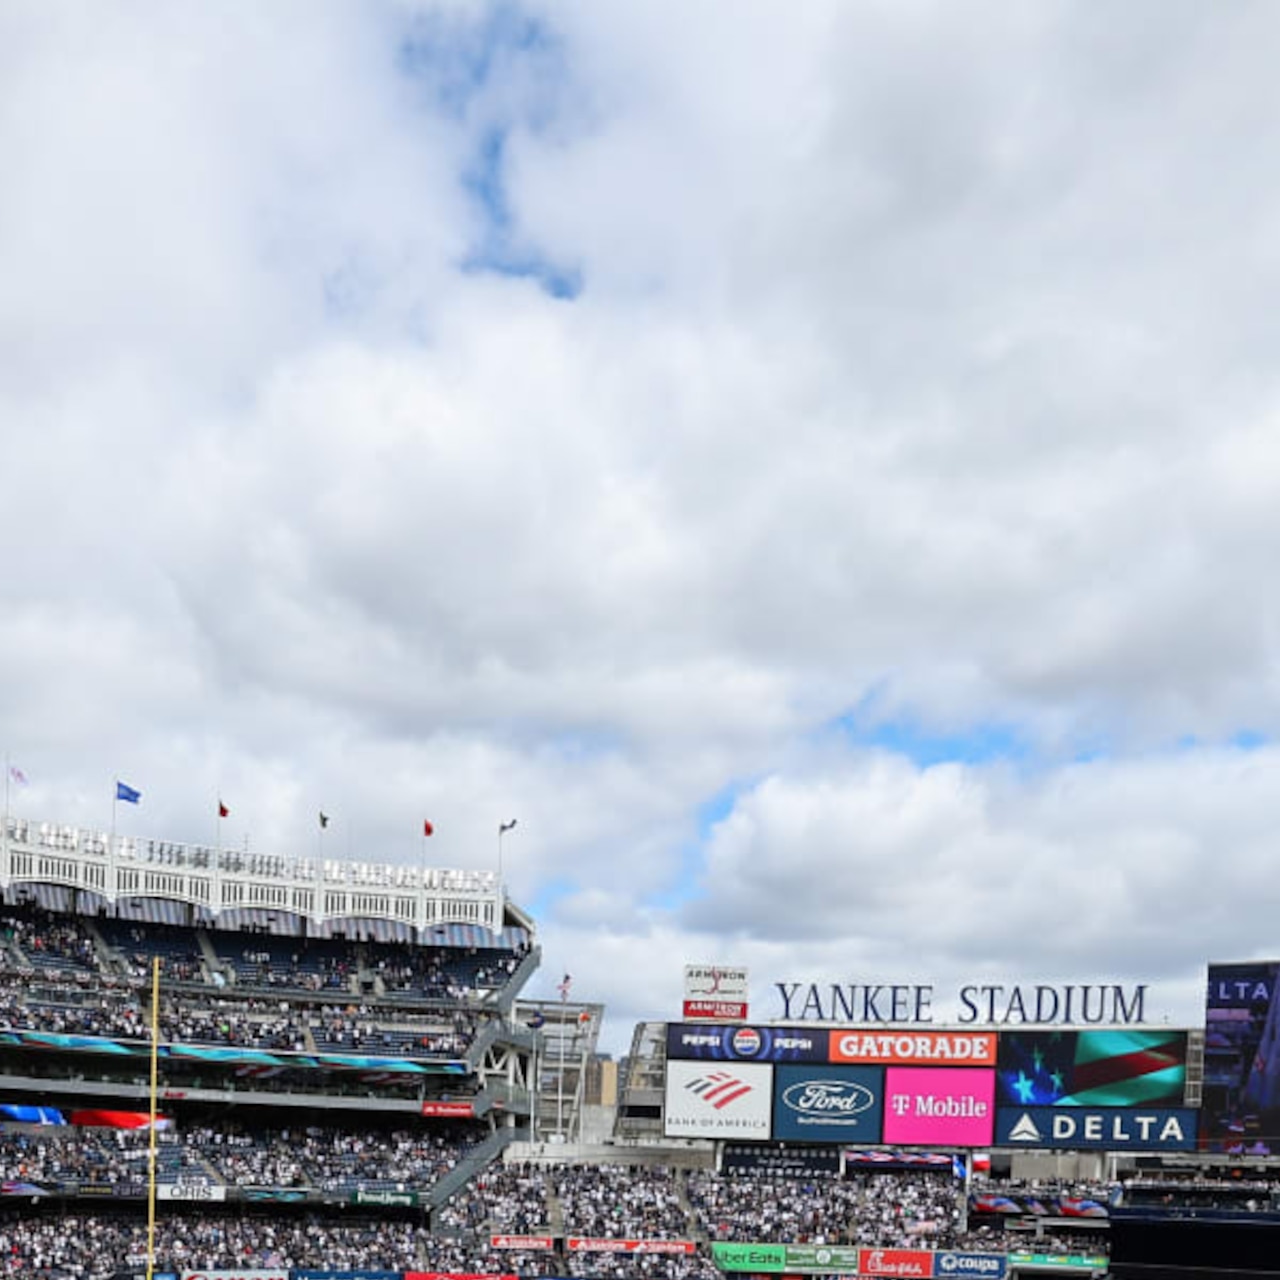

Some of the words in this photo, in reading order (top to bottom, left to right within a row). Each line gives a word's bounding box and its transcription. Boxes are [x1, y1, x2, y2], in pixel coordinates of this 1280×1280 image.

[775, 983, 933, 1023] YANKEE
[958, 985, 1149, 1024] STADIUM
[682, 1035, 720, 1046] PEPSI
[774, 1038, 812, 1050] PEPSI
[839, 1036, 989, 1059] GATORADE
[799, 1085, 857, 1111] Ford
[915, 1096, 988, 1118] Mobile
[668, 1117, 696, 1126] BANK
[701, 1119, 716, 1127] OF
[717, 1120, 767, 1129] AMERICA
[1053, 1115, 1185, 1141] DELTA
[170, 1184, 213, 1199] ORIS
[714, 1250, 748, 1263] Uber
[749, 1252, 782, 1264] Eats
[958, 1256, 1000, 1272] coupa
